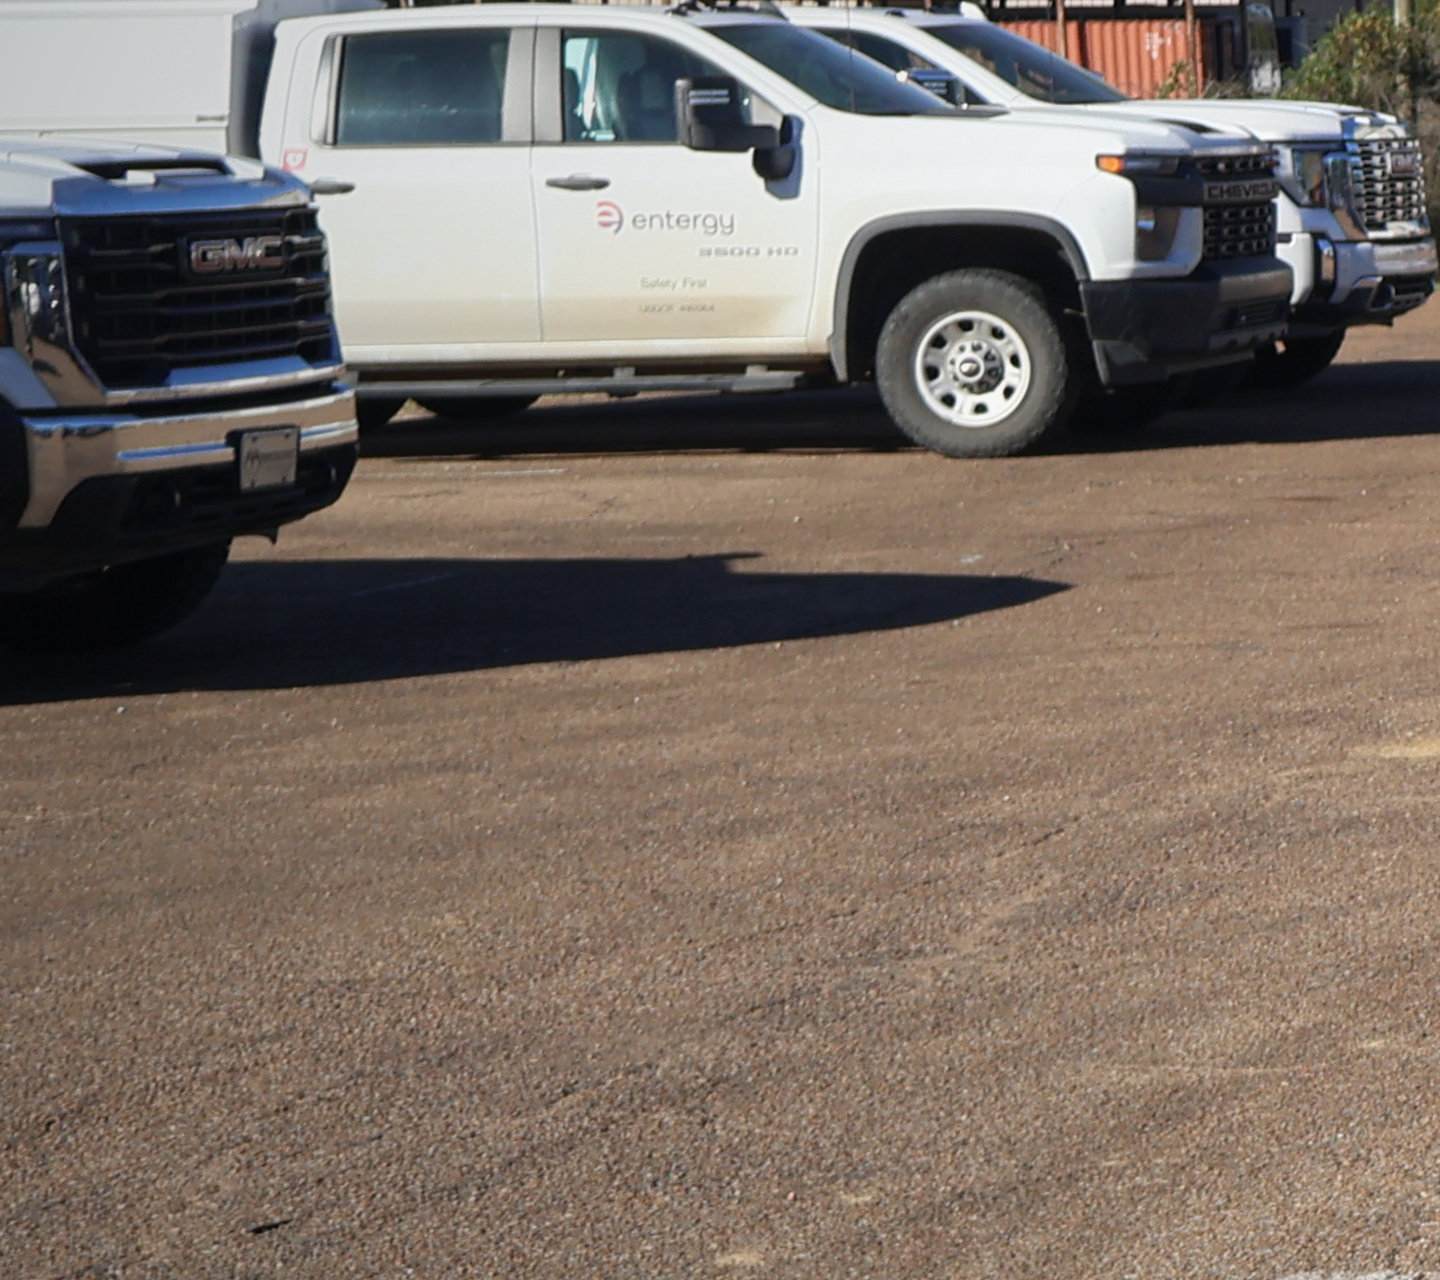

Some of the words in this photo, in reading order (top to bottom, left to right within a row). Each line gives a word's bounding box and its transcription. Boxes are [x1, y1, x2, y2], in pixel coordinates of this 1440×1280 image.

[631, 209, 736, 236] entergy
[190, 234, 285, 273] GMC
[698, 246, 761, 257] 3500
[767, 246, 799, 257] HD
